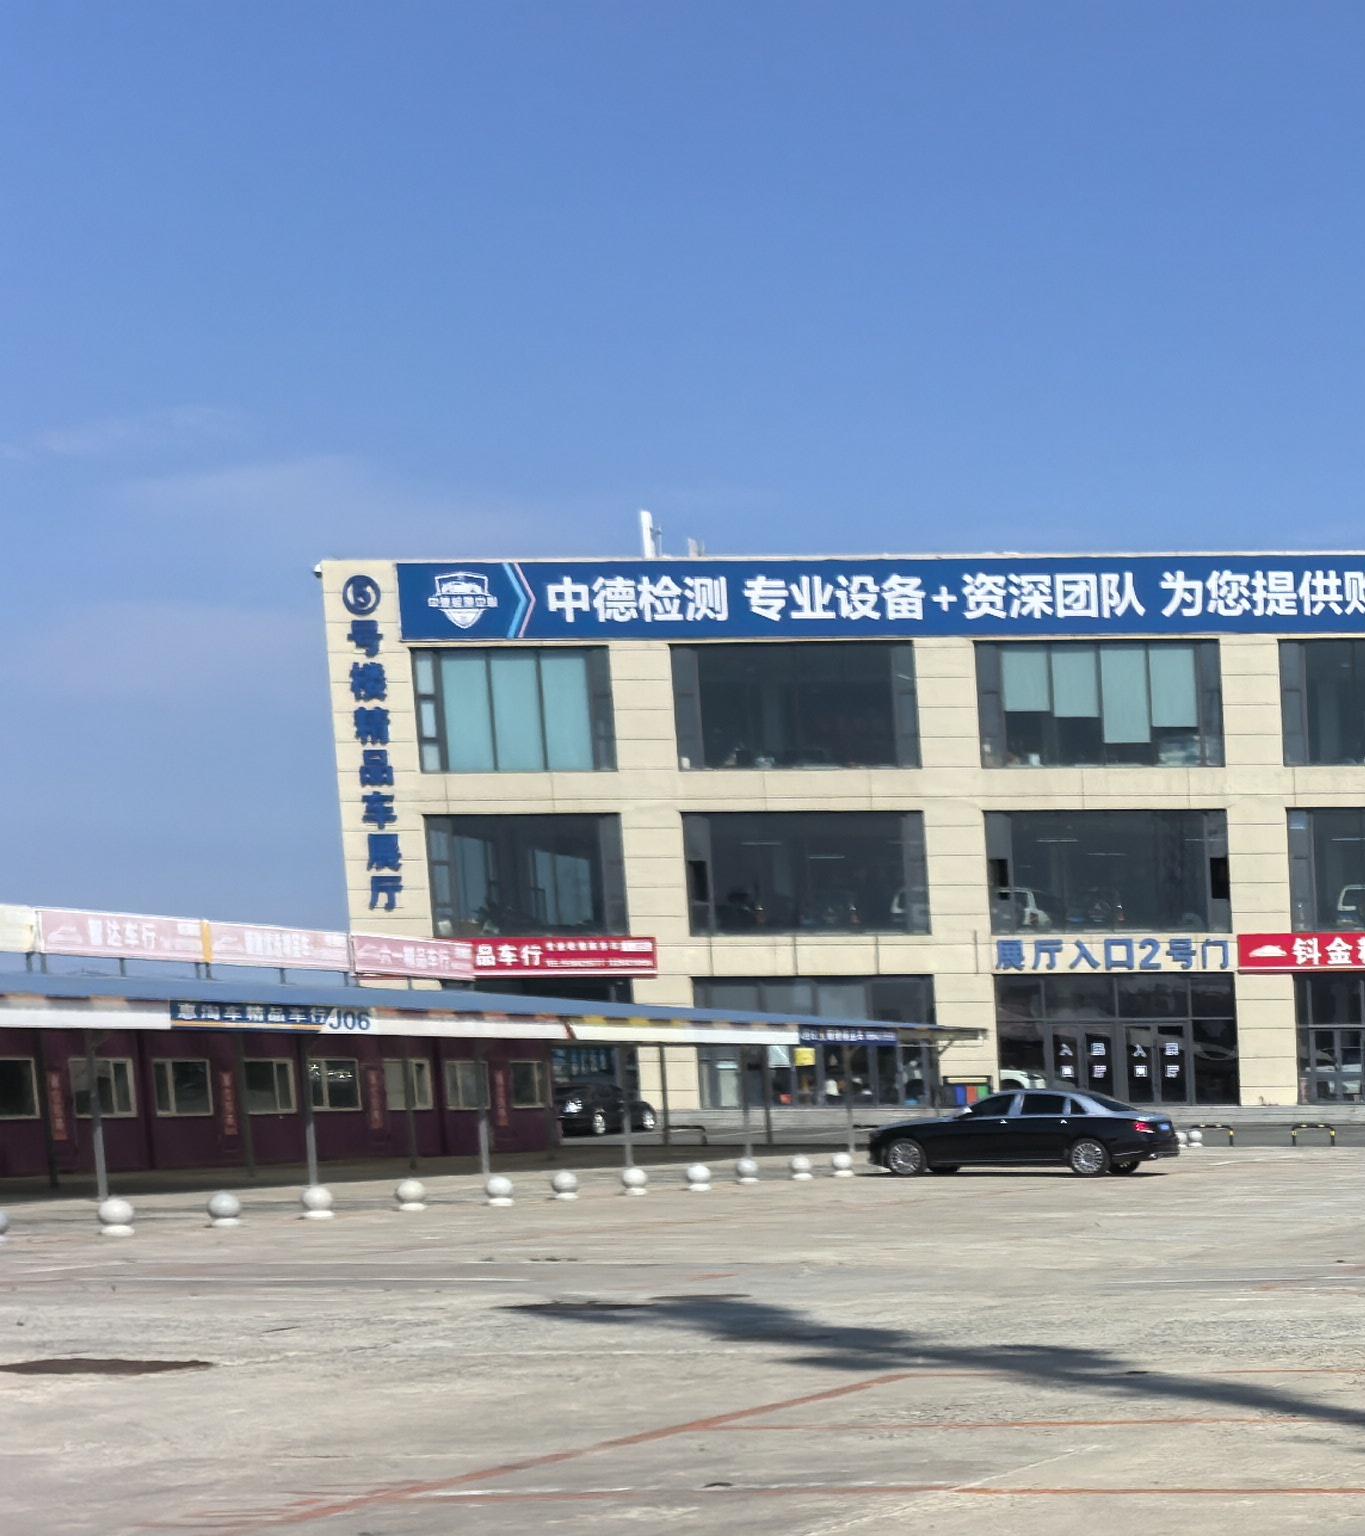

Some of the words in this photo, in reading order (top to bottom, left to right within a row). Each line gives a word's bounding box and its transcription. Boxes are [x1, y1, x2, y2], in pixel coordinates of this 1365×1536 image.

[546, 576, 728, 623] 中德检测
[742, 573, 1146, 621] 专业设备+资深团队
[476, 944, 543, 967] 品车行
[996, 938, 1229, 971] 展厅入口2号门
[330, 1010, 370, 1030] J06
